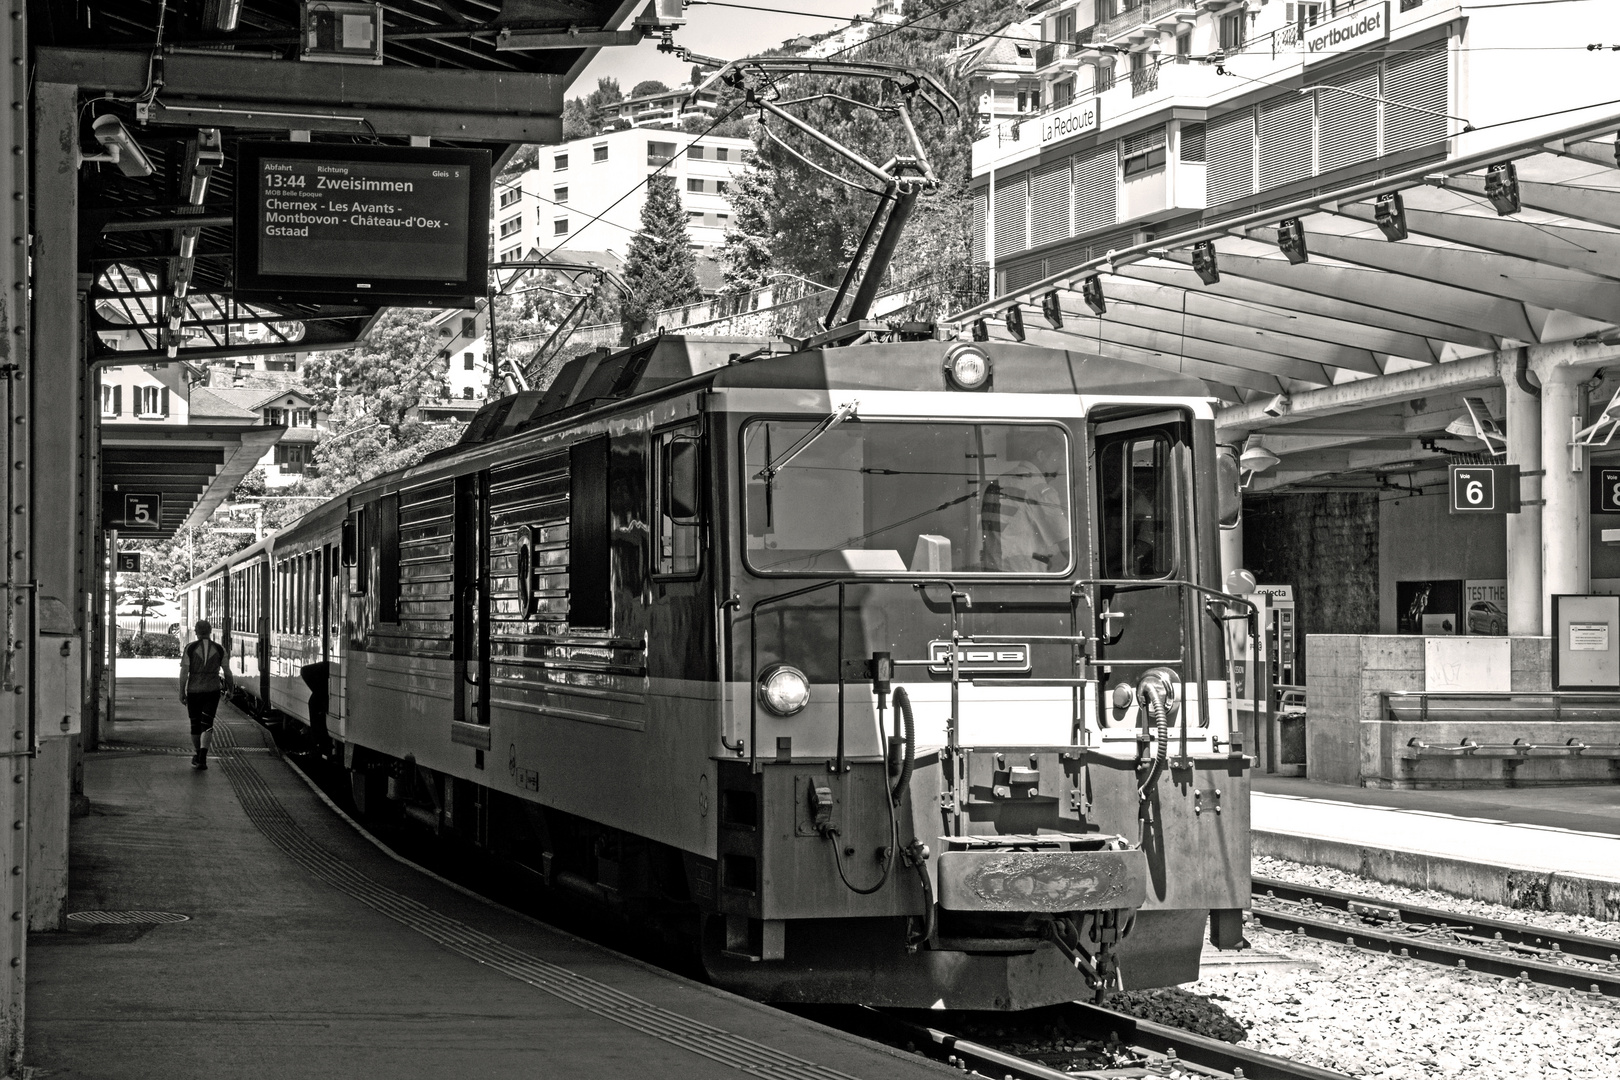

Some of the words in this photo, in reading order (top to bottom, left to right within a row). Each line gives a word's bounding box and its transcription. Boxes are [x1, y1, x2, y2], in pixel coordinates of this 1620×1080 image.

[1308, 11, 1380, 53] vertbaudet
[1042, 122, 1052, 142] La
[1054, 109, 1094, 138] Redoute
[264, 163, 293, 171] Abfahrt
[317, 165, 349, 175] Richtung
[432, 170, 450, 178] Gleis
[265, 174, 306, 188] 13:44
[316, 176, 413, 192] Zweisimmen
[298, 190, 323, 198] Epoque
[265, 198, 318, 211] Chernex
[329, 201, 349, 212] Les
[351, 202, 395, 214] Avants
[266, 211, 339, 225] Montbovon
[350, 214, 441, 228] Château-d'Oex
[265, 225, 309, 237] Gstaad
[1466, 480, 1484, 505] 6
[134, 504, 150, 523] 5
[126, 559, 134, 569] 5
[1467, 586, 1487, 601] TEST
[1489, 586, 1505, 601] THE
